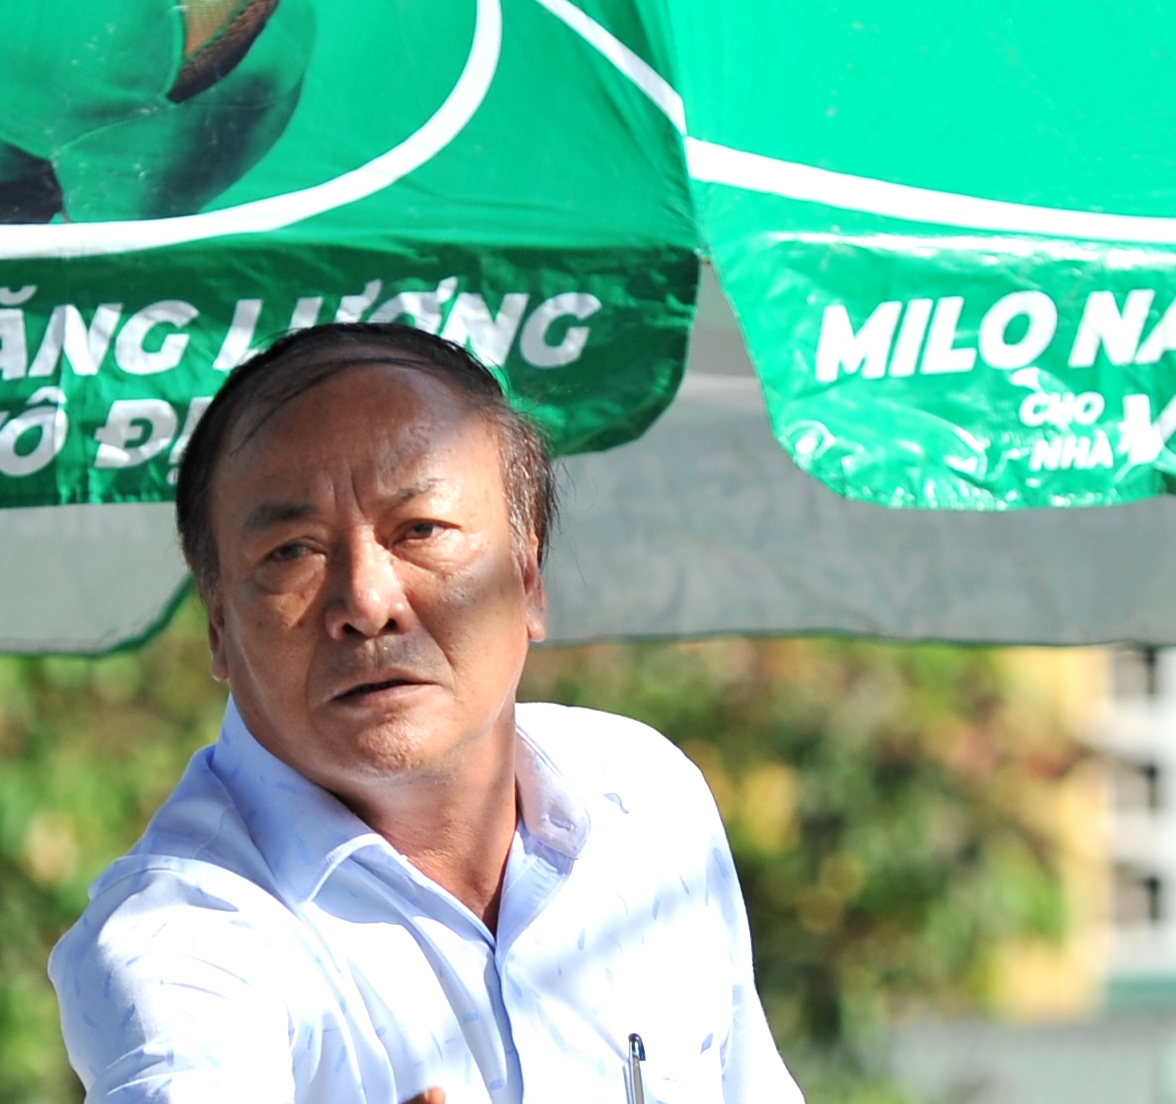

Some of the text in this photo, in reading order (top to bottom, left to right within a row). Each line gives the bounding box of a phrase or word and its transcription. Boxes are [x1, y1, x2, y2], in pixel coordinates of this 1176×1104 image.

[815, 290, 1058, 382] MILO
[1019, 391, 1106, 428] CHO
[1028, 429, 1114, 471] NHÀ
